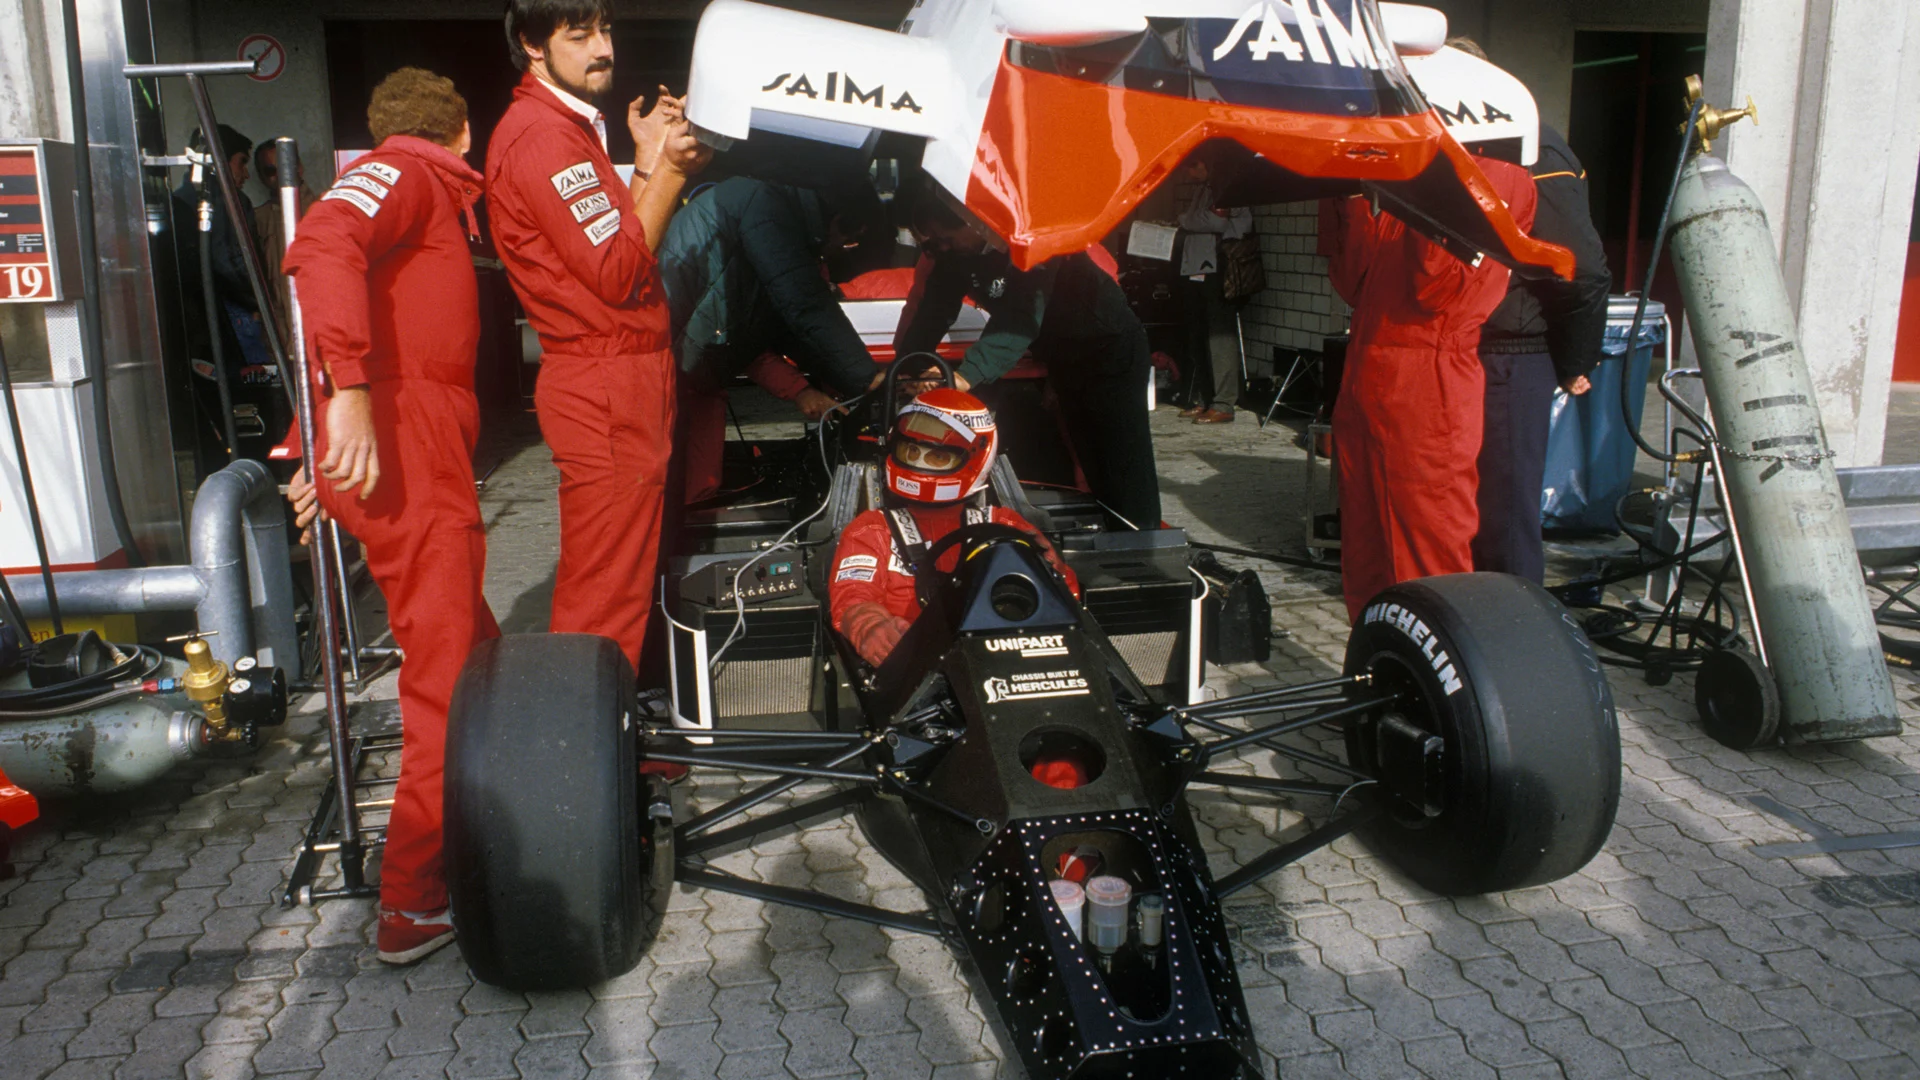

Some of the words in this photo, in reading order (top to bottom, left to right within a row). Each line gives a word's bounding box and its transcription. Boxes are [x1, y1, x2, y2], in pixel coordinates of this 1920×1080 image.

[761, 71, 923, 114] SAIMA
[560, 168, 596, 193] SAIMA
[575, 193, 607, 215] BOSS
[3, 266, 43, 298] 19
[898, 479, 919, 489] BOSS
[985, 635, 1064, 652] UNIPART
[1364, 603, 1463, 696] MICHELIN
[1010, 678, 1088, 693] HERCULES
[1011, 672, 1047, 682] CHASSIS
[1046, 670, 1068, 679] BUILT
[1068, 669, 1079, 677] BY
